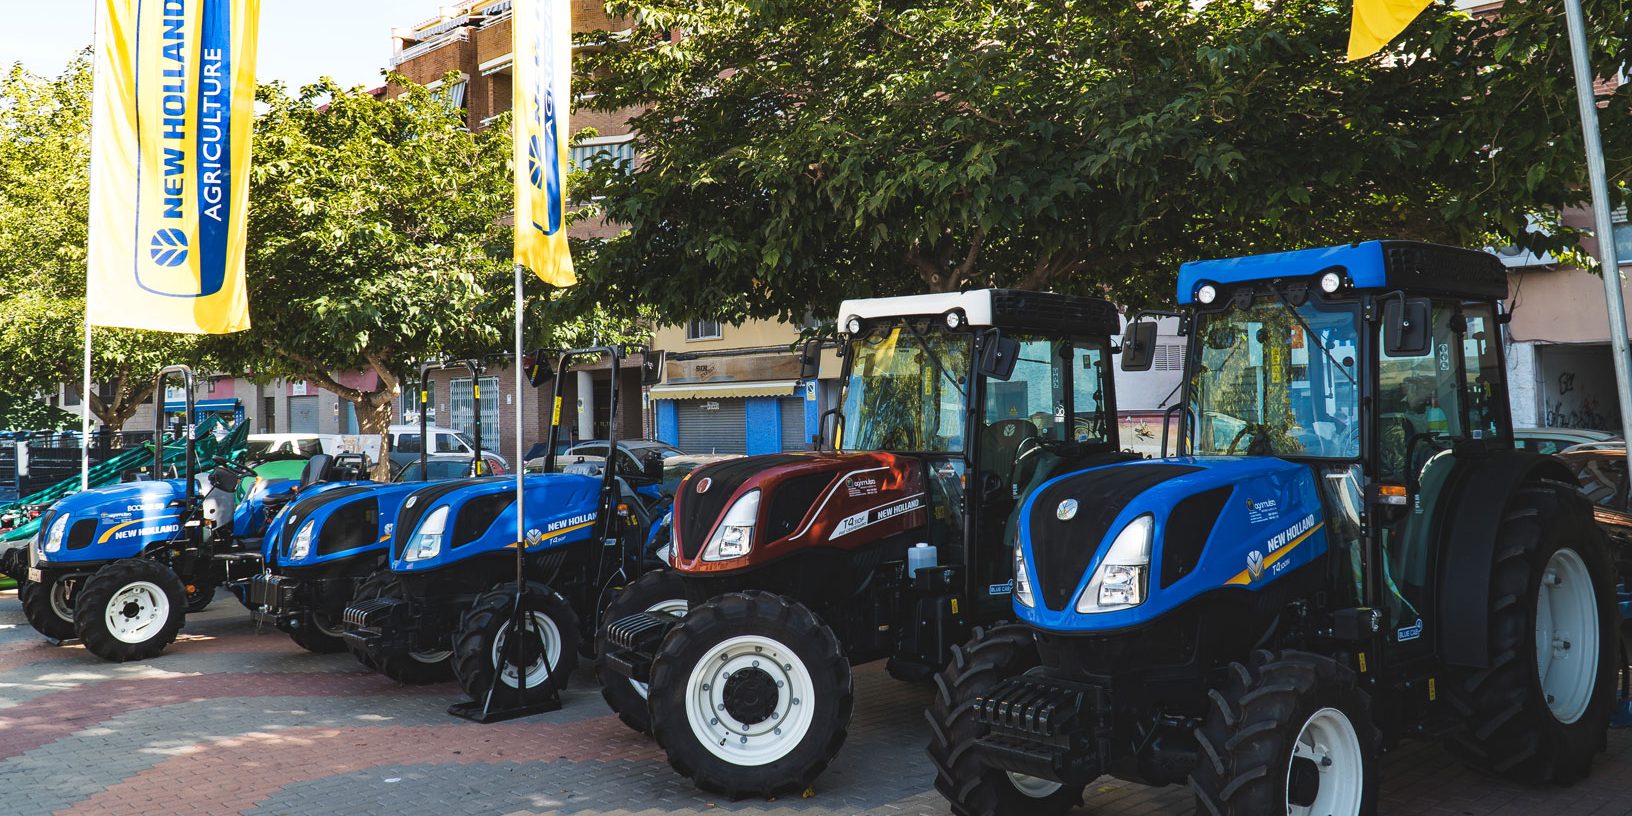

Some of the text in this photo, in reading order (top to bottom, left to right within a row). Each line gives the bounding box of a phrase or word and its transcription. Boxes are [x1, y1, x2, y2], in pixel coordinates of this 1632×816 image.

[162, 0, 186, 219] NEW HOLLAND
[203, 48, 222, 222] AGRICULTURE
[548, 512, 597, 531] NEW HOLLAN
[877, 498, 919, 520] NEW HOLLAND
[115, 529, 137, 540] NEW
[1267, 531, 1286, 553] NEW
[1286, 513, 1315, 542] HOLLAND
